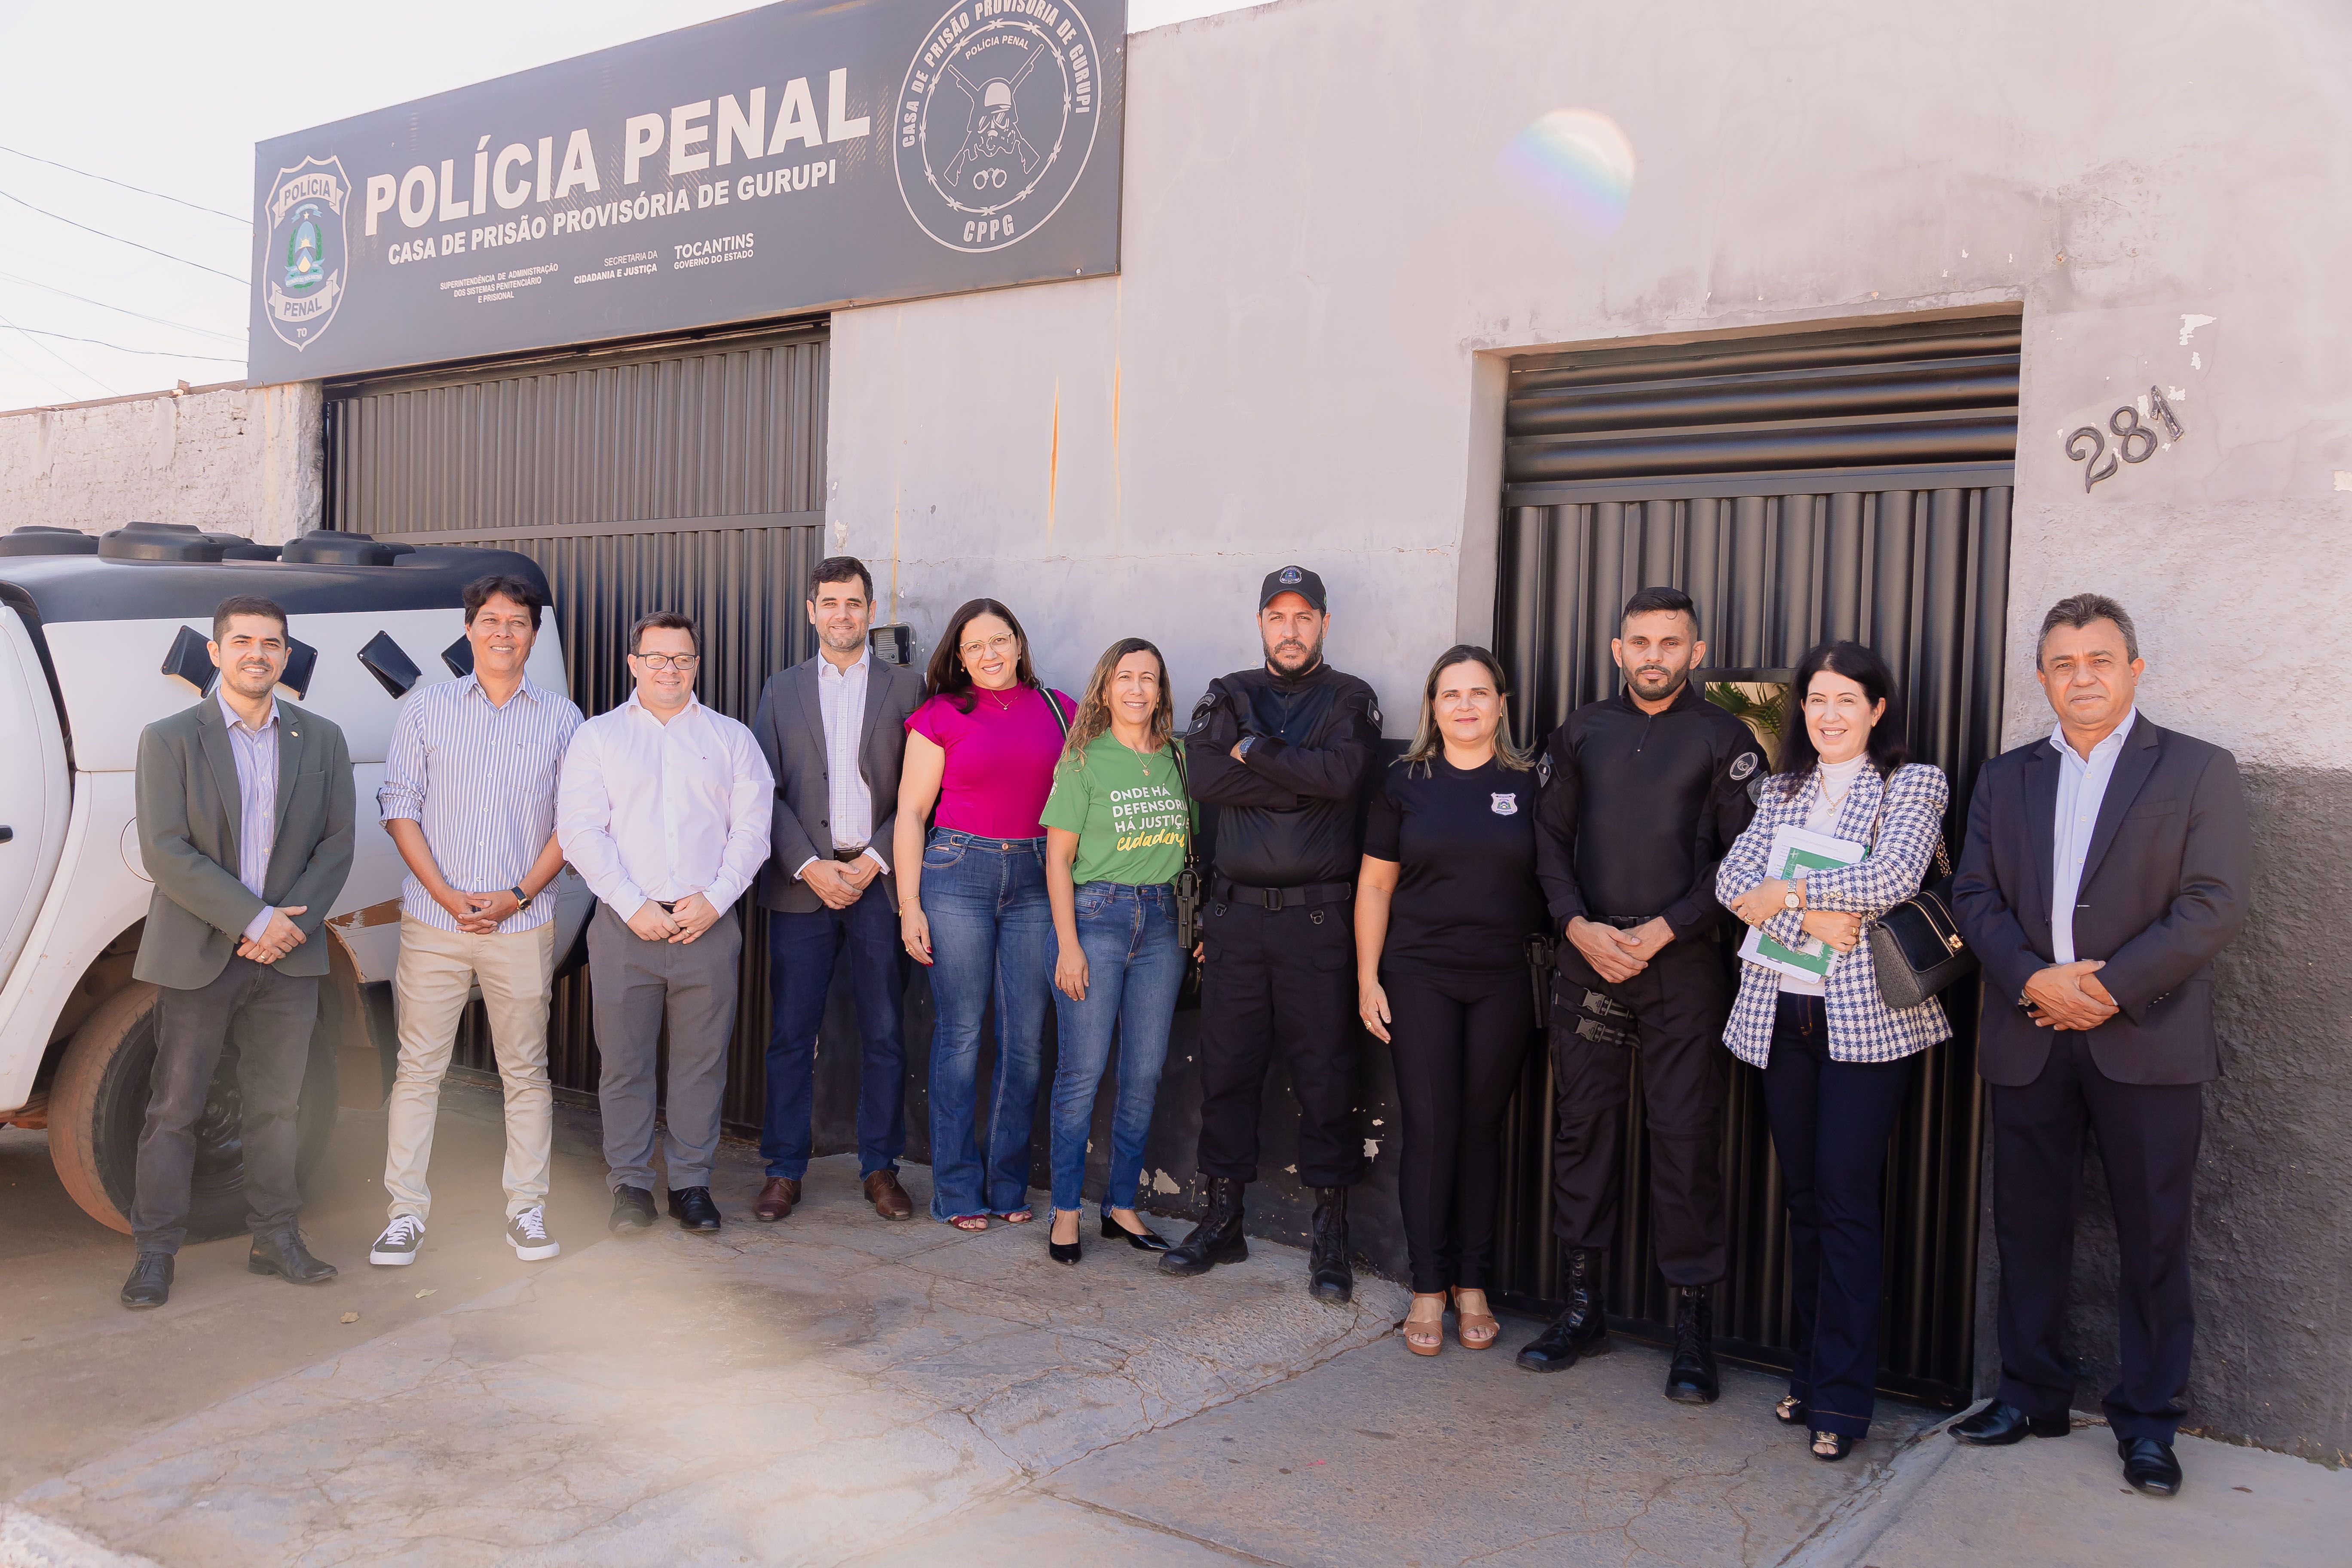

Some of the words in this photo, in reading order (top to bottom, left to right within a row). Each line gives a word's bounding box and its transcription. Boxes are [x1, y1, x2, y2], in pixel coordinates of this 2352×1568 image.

[965, 36, 1000, 60] POLÍCIA
[1001, 35, 1029, 50] PENAL
[903, 101, 919, 148] CASA
[911, 70, 928, 93] DE
[924, 11, 970, 67] PRISÃO
[1056, 18, 1077, 46] DE
[1069, 43, 1090, 113] GURUPI
[365, 128, 599, 236] POLÍCIA
[623, 67, 870, 184] PENAL
[284, 176, 331, 206] POLÍCIA
[388, 237, 436, 265] CASA
[441, 231, 466, 256] DE
[471, 214, 546, 251] PRISÃO
[552, 191, 690, 236] PROVISÓRIA
[697, 181, 729, 208] DE
[736, 159, 836, 201] GURUPI
[963, 214, 1014, 242] CPPG
[674, 233, 754, 260] TOCANTINS
[603, 253, 646, 267] SECRETARIA
[647, 250, 658, 259] DA
[674, 258, 709, 270] GOVERNO
[724, 249, 754, 260] ESTADO
[440, 274, 496, 290] SUPERINTENDÊNCIA
[497, 272, 506, 280] DE
[508, 262, 559, 279] ADMINISTRAÇÃO
[466, 284, 496, 295] SISTEMAS
[496, 276, 542, 291] PENITENCIÁRIO
[573, 270, 616, 285] CIDADANIA
[616, 268, 622, 278] E
[623, 263, 658, 277] JUSTIÇA
[283, 298, 322, 316] PENAL
[483, 291, 515, 303] PRISIONAL
[297, 328, 307, 337] TO
[2065, 385, 2184, 494] 281
[1110, 787, 1150, 802] ONDE
[1151, 783, 1171, 796] HÁ
[1115, 816, 1136, 833] HÁ
